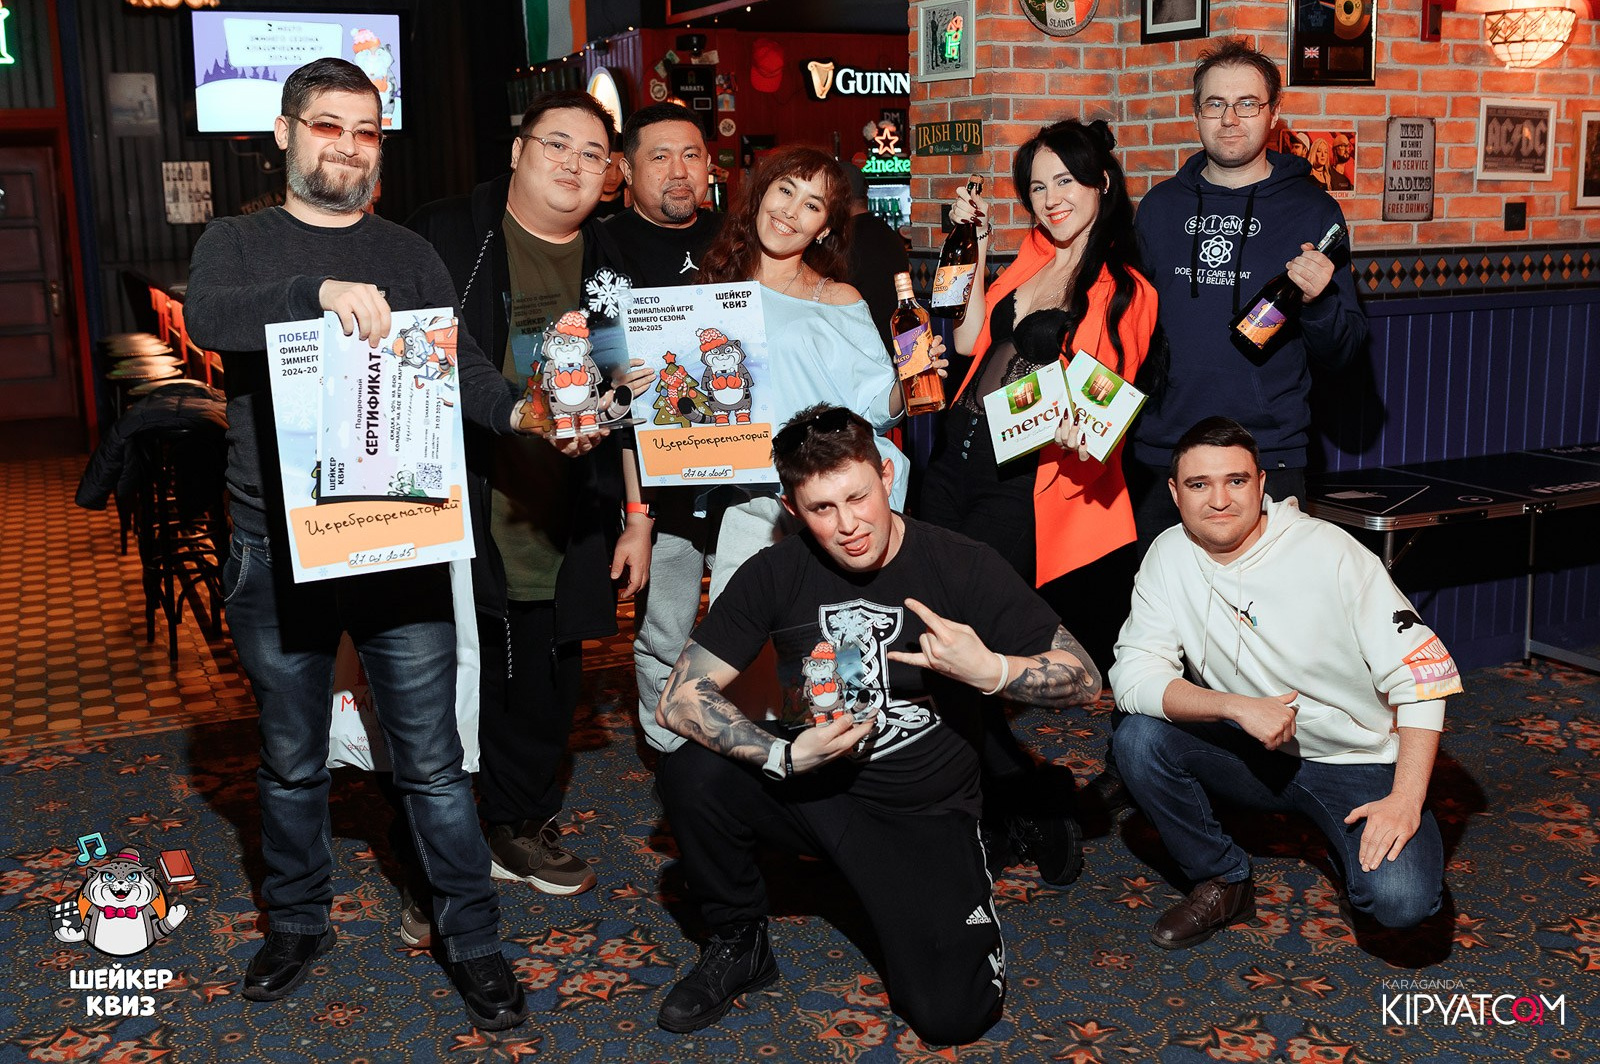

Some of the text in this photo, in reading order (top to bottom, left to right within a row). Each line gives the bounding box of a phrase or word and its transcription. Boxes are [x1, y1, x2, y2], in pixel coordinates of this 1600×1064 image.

[1049, 17, 1076, 29] SLÁINTE
[835, 68, 911, 95] GUINN
[917, 123, 981, 149] IRISH PUB
[1400, 123, 1425, 139] MEN
[1485, 117, 1548, 158] AC/DC
[1401, 140, 1422, 148] NO SHIRT
[1400, 150, 1422, 158] NO SHOES
[1392, 160, 1429, 171] NO SERVICE
[1388, 176, 1432, 192] LADIES
[1405, 194, 1420, 202] SHIRT
[1388, 203, 1429, 214] FREE DRINKS
[1206, 269, 1226, 278] CARE
[1206, 276, 1235, 286] BELIEVE
[715, 289, 753, 301] ШЕЙКЕР
[632, 304, 676, 315] ФИНАЛЬНОЙ
[676, 305, 694, 313] ИГРЕ
[722, 300, 748, 310] КВИЗ
[515, 316, 546, 328] ШЕЙКЕР
[628, 314, 686, 324] ЗИМНЕГО СЕЗОНА
[628, 324, 663, 332] 2024-2025
[279, 330, 319, 343] ПОБЕД
[280, 344, 319, 355] ФИНАЛЬ
[282, 366, 318, 377] 2024-20
[355, 378, 363, 429] Подарочный
[365, 352, 381, 456] СЕРТИФИКАТ
[1001, 401, 1061, 442] merci
[652, 430, 769, 452] Цереброкрематорий
[328, 457, 337, 491] ШЕЙКЕР
[337, 462, 345, 485] КВИЗ
[304, 499, 460, 536] Цереброкрематорий
